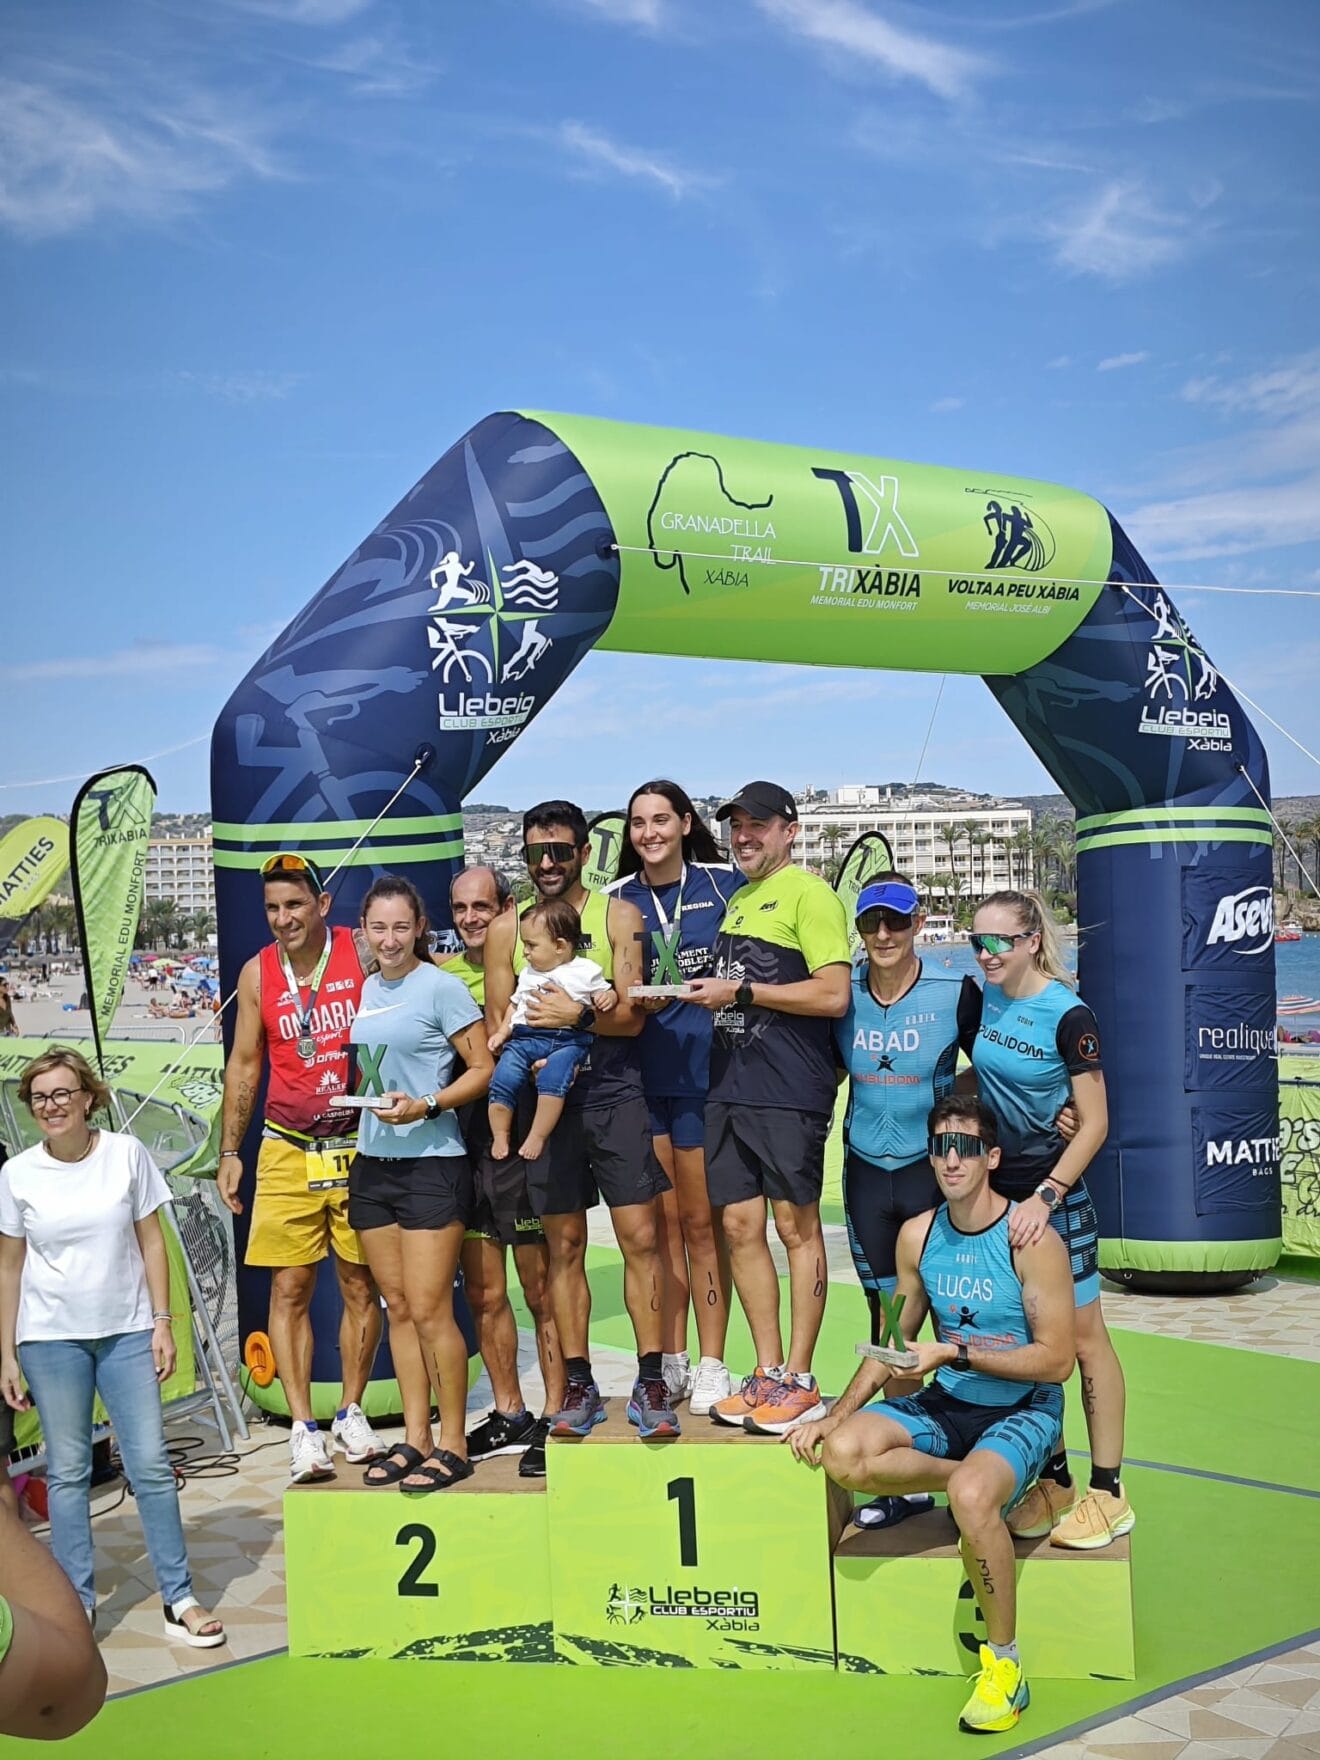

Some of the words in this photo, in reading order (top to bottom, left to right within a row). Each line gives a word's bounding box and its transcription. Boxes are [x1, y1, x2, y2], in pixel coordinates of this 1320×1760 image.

[661, 511, 776, 539] GRANADELLA
[730, 544, 776, 565] TRAIL
[819, 564, 921, 598] TRIXÀBIA
[948, 579, 992, 596] VOLTA
[993, 583, 1005, 597] A
[1006, 583, 1035, 598] PEU
[1036, 582, 1080, 601] XÀBIA
[811, 595, 856, 608] MEMORIAL
[857, 598, 876, 609] EDU
[876, 600, 919, 611] MONFORT
[965, 601, 1008, 612] MEMORIAL
[443, 718, 477, 728] CLUB
[1141, 724, 1175, 734] CLUB
[1178, 727, 1230, 737] ESPORTIU
[1187, 737, 1233, 752] Xàbia
[124, 849, 147, 915] MONFORT
[118, 917, 133, 945] EDU
[101, 948, 127, 1016] MEMORIAL
[853, 1028, 920, 1052] ABAD
[980, 1023, 1044, 1061] PUBLIDOM
[1252, 1167, 1273, 1177] BAGS
[937, 1273, 993, 1301] LUCAS
[667, 1477, 698, 1567] 1
[395, 1523, 439, 1597] 2
[975, 1558, 995, 1594] 35
[649, 1585, 759, 1607] Llebeig
[652, 1606, 687, 1616] CLUB
[691, 1607, 757, 1617] ESPORTIU
[705, 1618, 760, 1632] Xàbia
